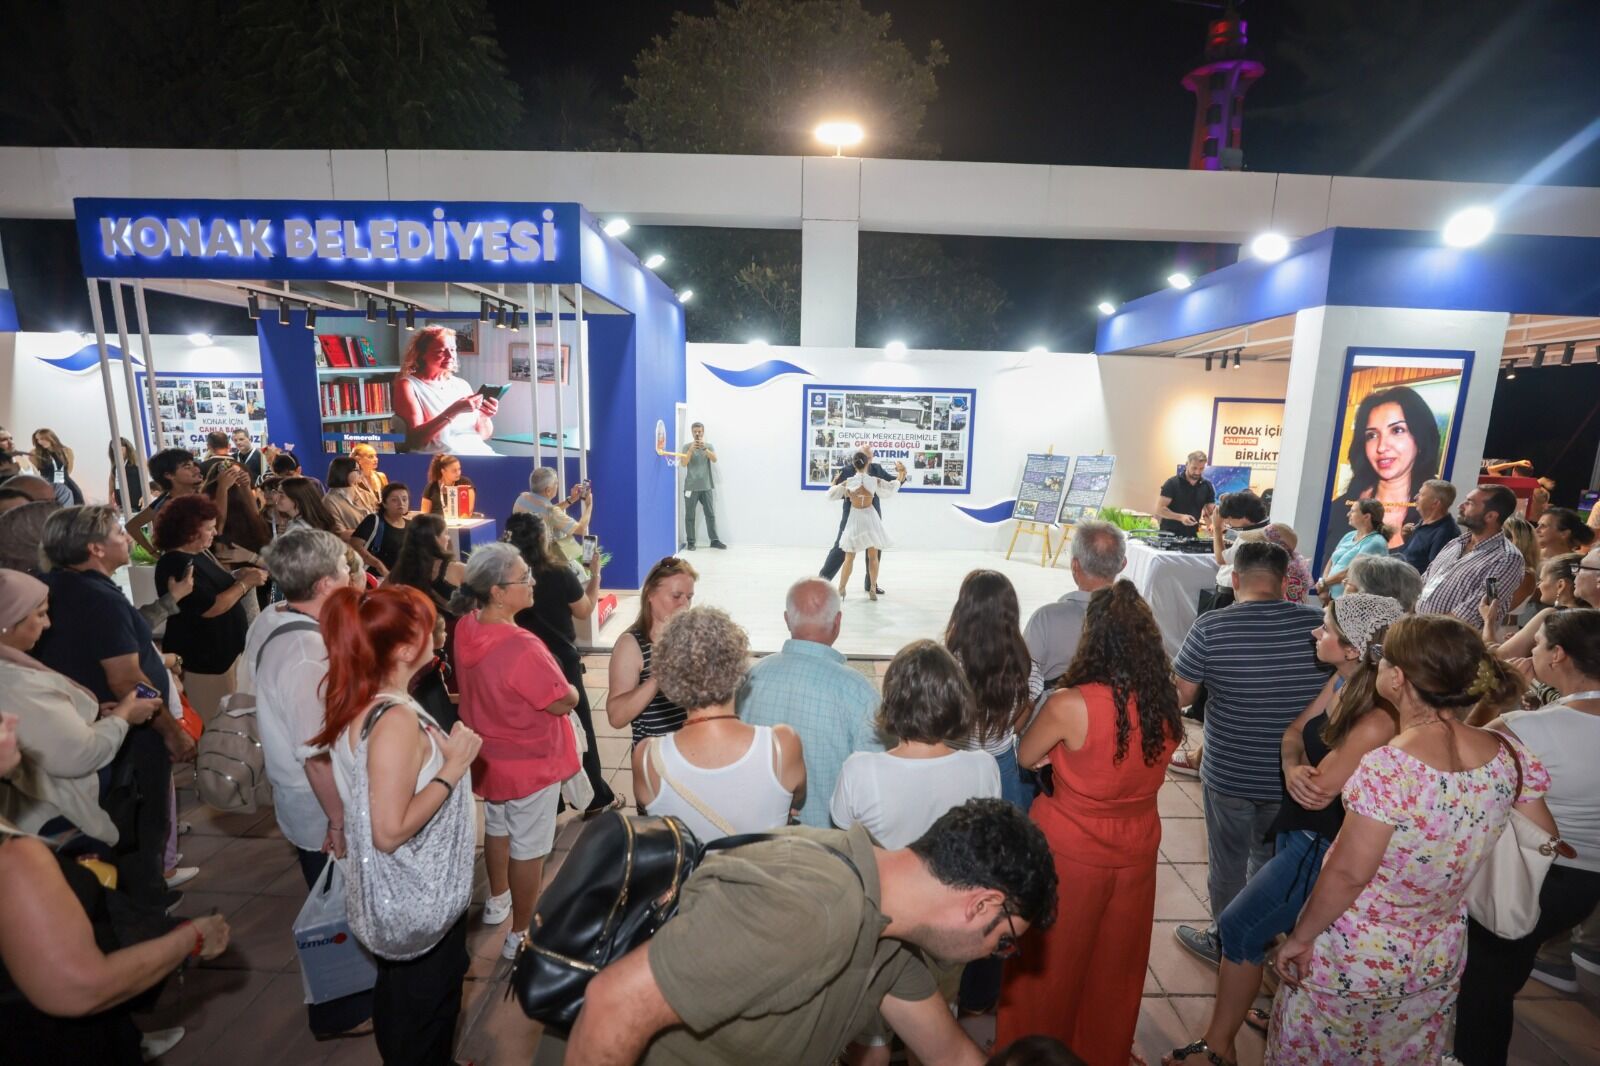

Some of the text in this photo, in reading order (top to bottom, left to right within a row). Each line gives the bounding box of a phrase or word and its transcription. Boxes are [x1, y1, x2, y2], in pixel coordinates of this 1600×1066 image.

[99, 207, 556, 262] KONAK BELEDİYESİ
[228, 417, 244, 426] İÇİN
[1223, 425, 1262, 436] KONAK
[838, 431, 871, 440] GENÇLİK
[894, 441, 921, 449] GÜÇLÜ
[873, 450, 910, 458] ATIRIM
[1235, 448, 1279, 461] BİRLİKT
